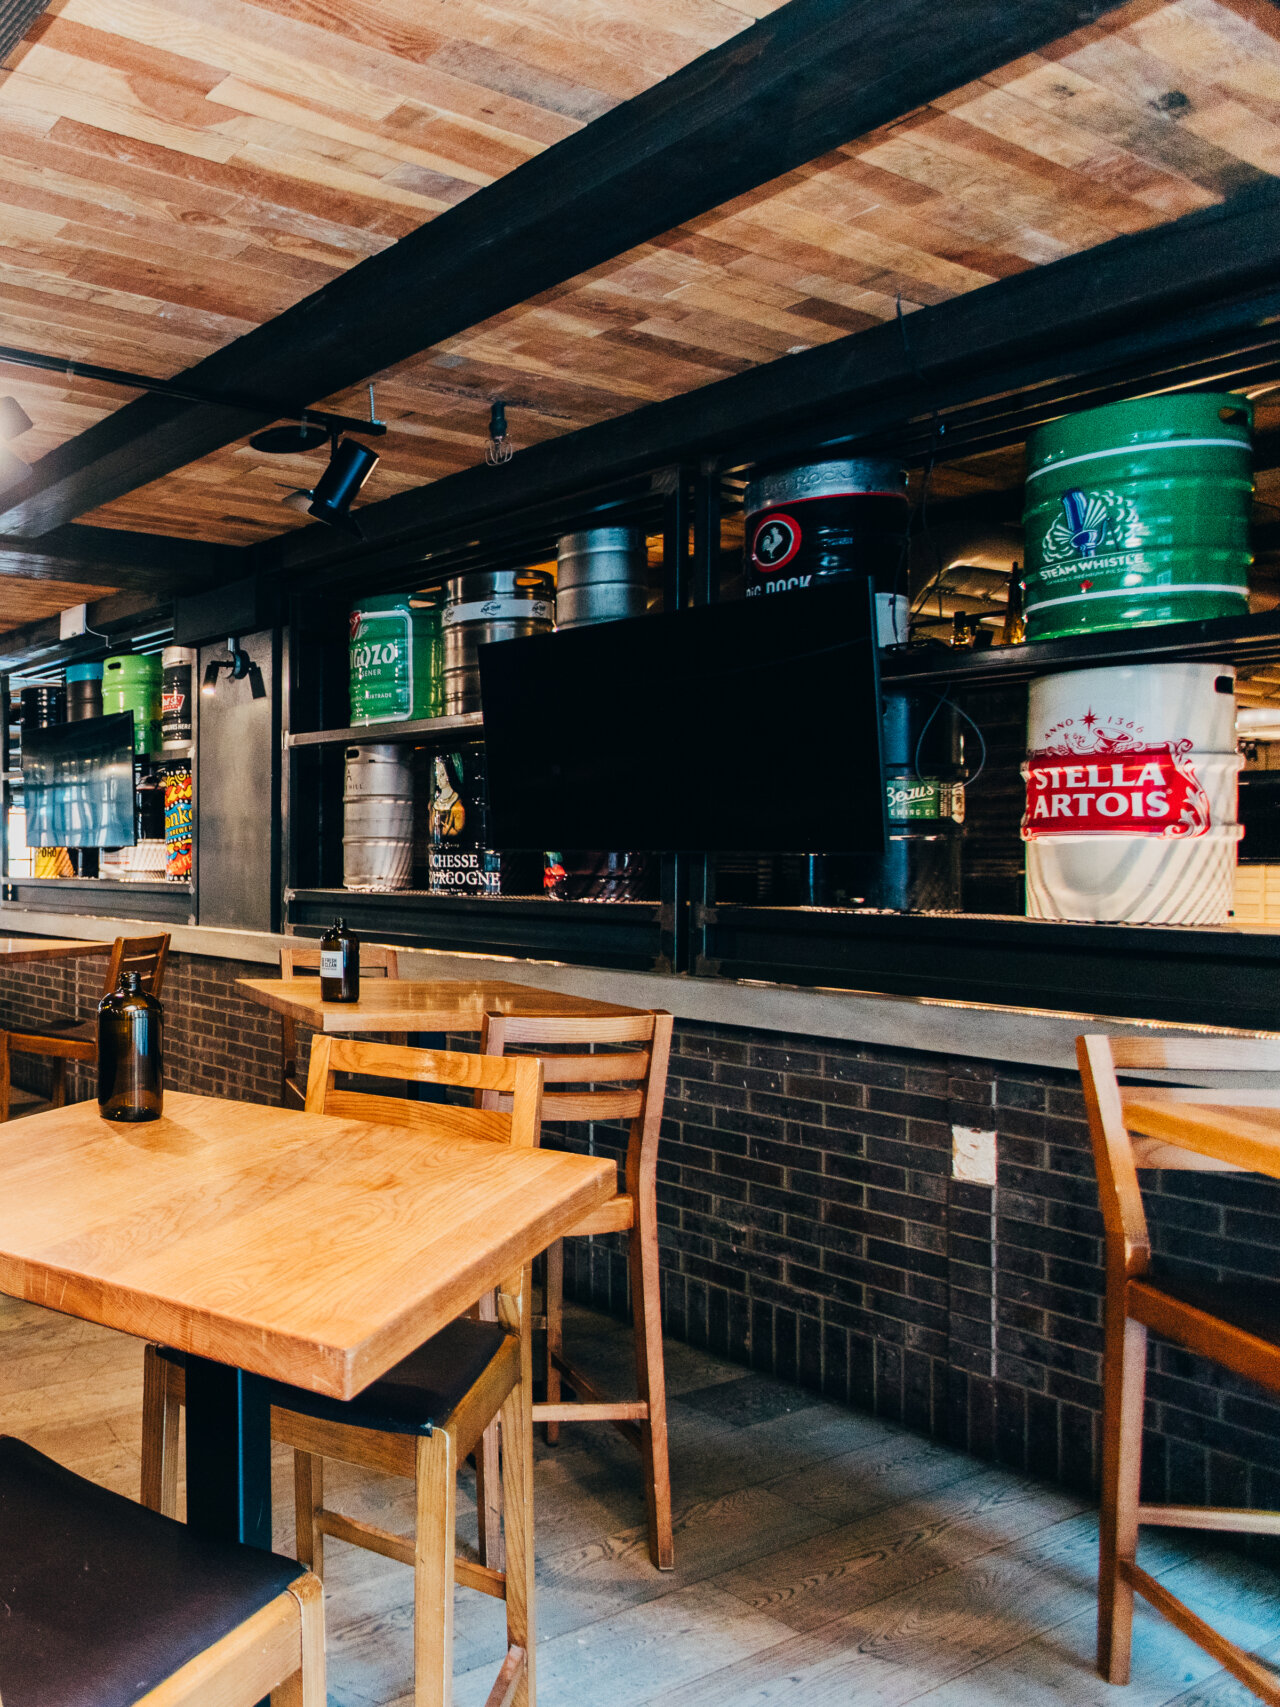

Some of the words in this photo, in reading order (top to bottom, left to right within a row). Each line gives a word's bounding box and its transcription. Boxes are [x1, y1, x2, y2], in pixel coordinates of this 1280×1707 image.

[1040, 565, 1077, 580] STEAM
[1078, 553, 1144, 571] WHISTLE
[1045, 718, 1074, 740] ANNO
[1108, 716, 1145, 733] 1366
[1034, 762, 1166, 790] STELLA
[1034, 791, 1170, 819] ARTOIS
